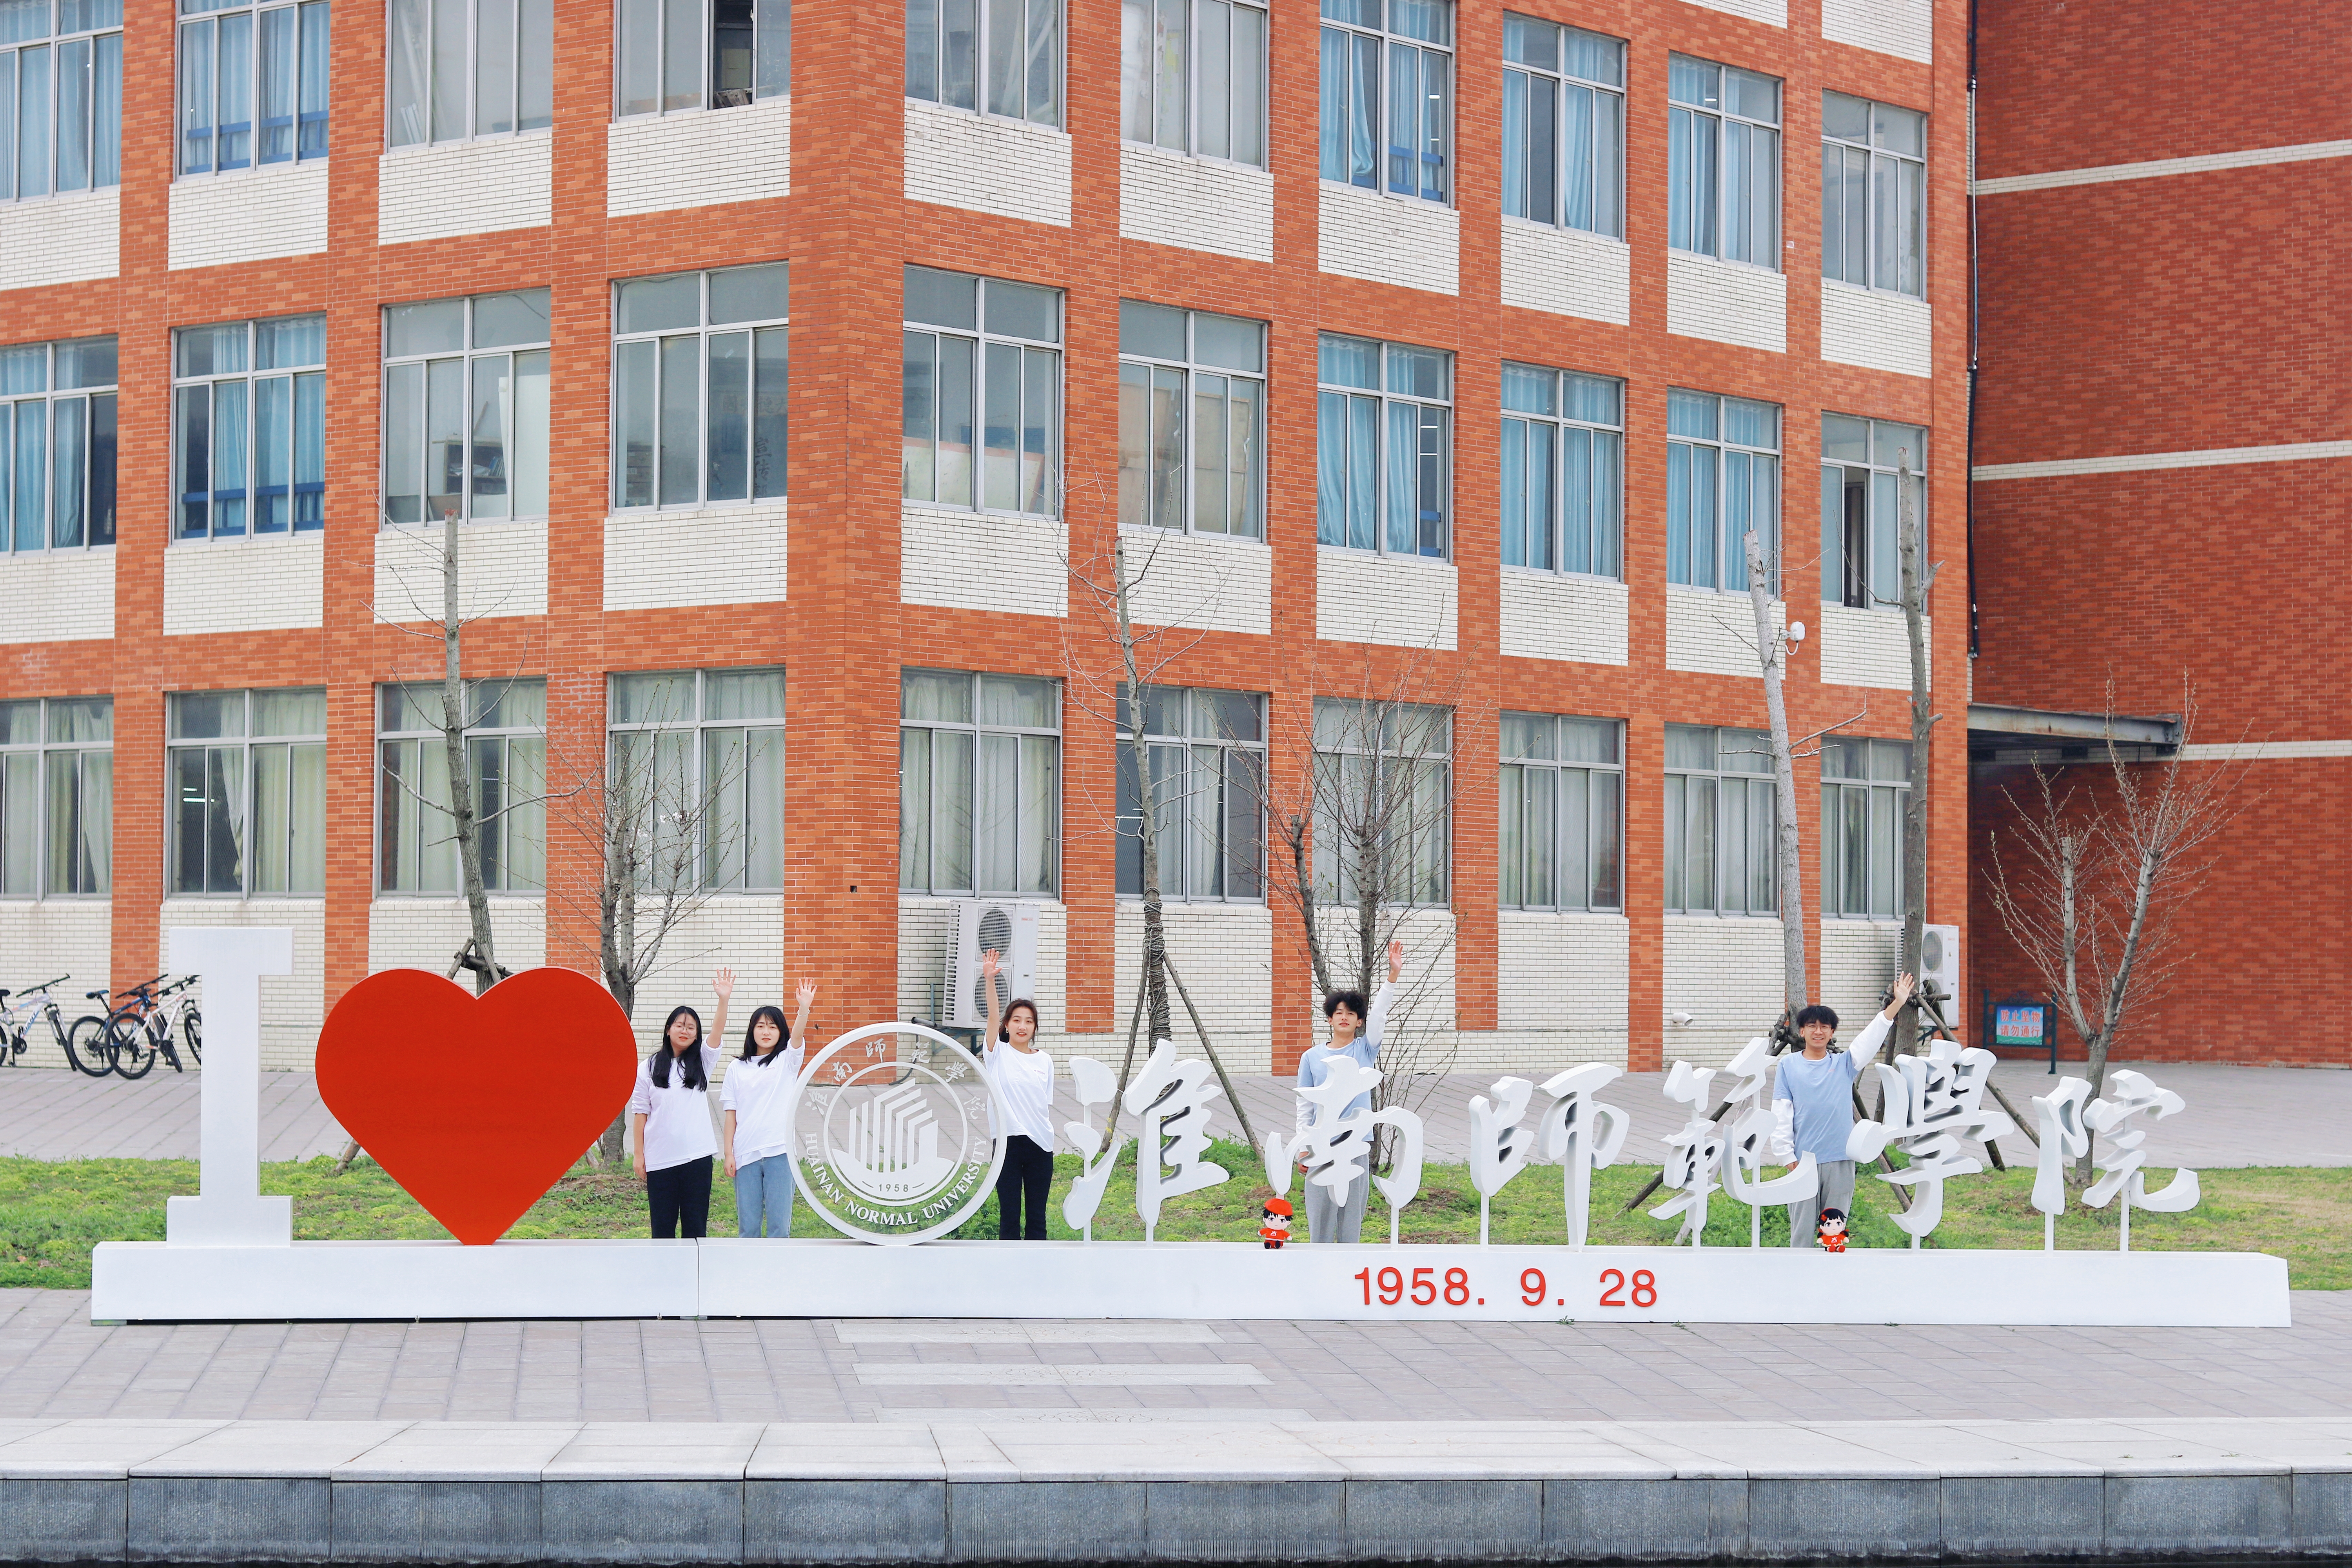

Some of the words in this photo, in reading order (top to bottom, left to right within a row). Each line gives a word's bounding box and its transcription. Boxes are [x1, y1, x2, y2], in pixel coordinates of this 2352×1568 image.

[2001, 1009, 2041, 1023] 防止坠物
[2000, 1025, 2040, 1038] 请勿通行
[805, 1132, 844, 1203] HUAINAN
[844, 1200, 918, 1226] NORMAL
[922, 1136, 987, 1219] UNIVERSITY
[878, 1184, 909, 1192] 1958
[1599, 1269, 1657, 1307] 28
